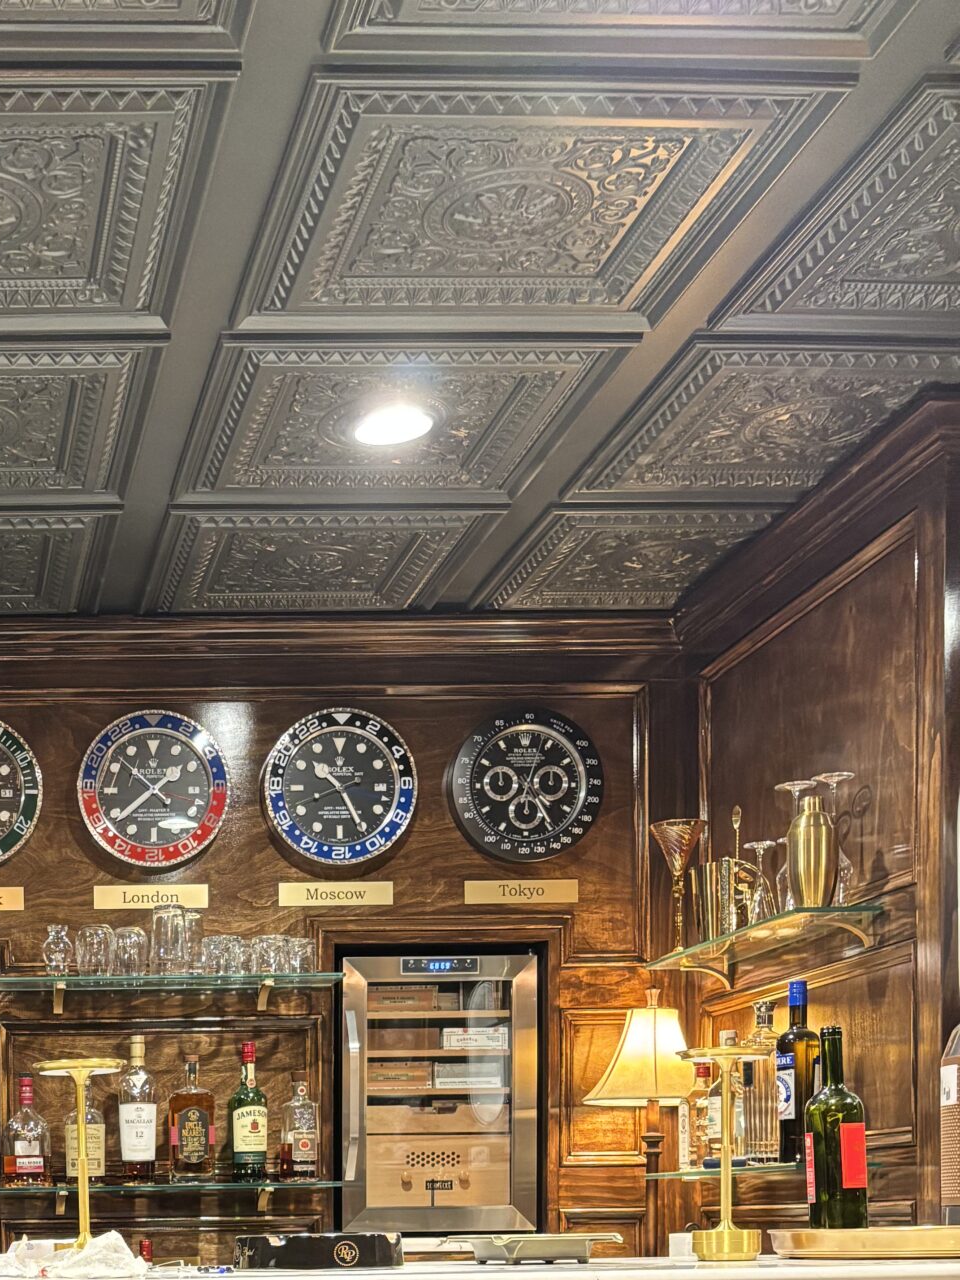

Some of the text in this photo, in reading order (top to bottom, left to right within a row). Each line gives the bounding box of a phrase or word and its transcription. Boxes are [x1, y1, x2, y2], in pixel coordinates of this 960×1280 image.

[108, 720, 133, 741] 22
[178, 722, 194, 736] 2
[296, 718, 321, 739] 22
[365, 720, 380, 735] 2
[16, 750, 30, 765] 10
[88, 744, 107, 768] 20
[204, 746, 217, 759] 4
[275, 744, 294, 767] 20
[391, 745, 405, 759] 4
[585, 758, 598, 766] 300
[83, 779, 95, 800] 18
[214, 779, 226, 793] 6
[270, 777, 283, 798] 18
[400, 776, 413, 790] 6
[589, 778, 602, 786] 240
[587, 796, 600, 804] 200
[90, 813, 108, 834] 16
[205, 813, 219, 827] 8
[276, 811, 293, 831] 16
[392, 809, 406, 824] 8
[14, 816, 31, 835] 20
[114, 838, 132, 855] 14
[177, 837, 198, 854] 10
[300, 836, 319, 854] 14
[365, 834, 386, 851] 10
[549, 842, 561, 850] 140
[560, 836, 572, 844] 150
[145, 849, 165, 861] 12
[331, 846, 352, 859] 12
[533, 846, 545, 854] 130
[122, 890, 179, 904] London
[305, 887, 367, 901] Moscow
[498, 884, 546, 899] Tokyo
